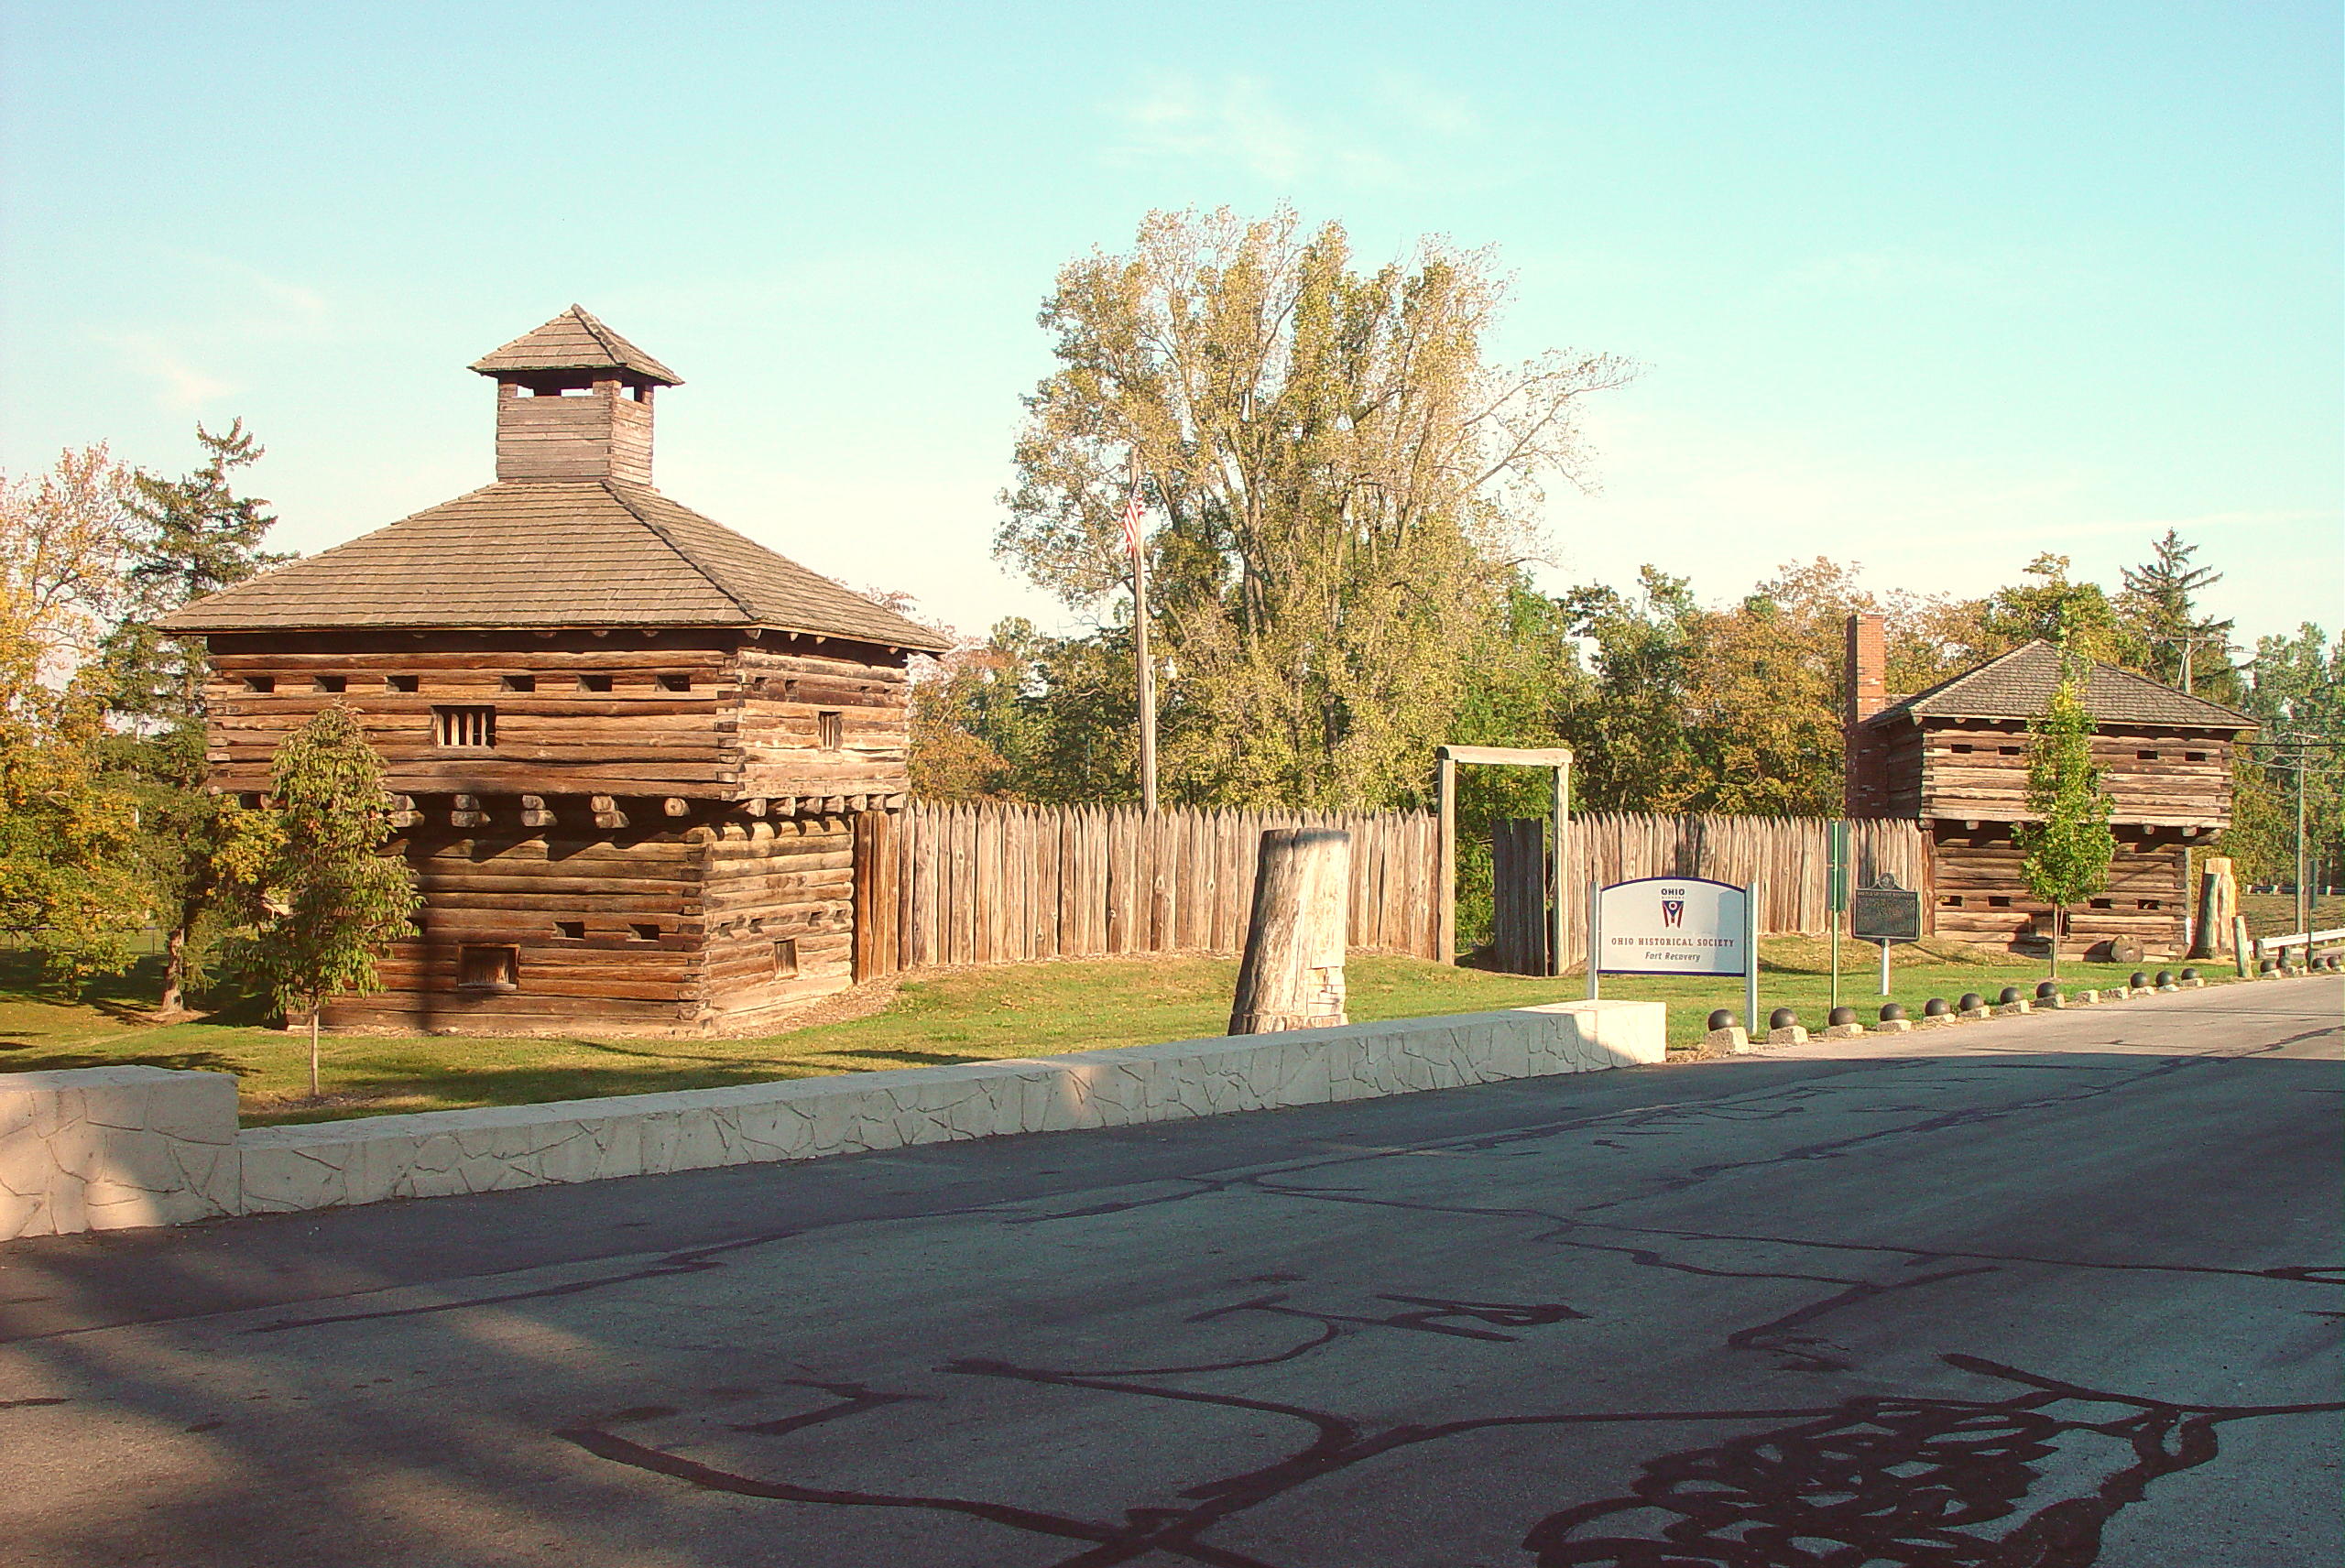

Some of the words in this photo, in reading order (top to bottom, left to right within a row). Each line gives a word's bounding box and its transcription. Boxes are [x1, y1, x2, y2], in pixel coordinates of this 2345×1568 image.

[1611, 938, 1634, 946] OHIO
[1638, 938, 1694, 947] HISTORICAL
[1696, 938, 1735, 947] SOCIETY
[1644, 952, 1663, 961] Fort
[1665, 952, 1701, 963] Recovery
